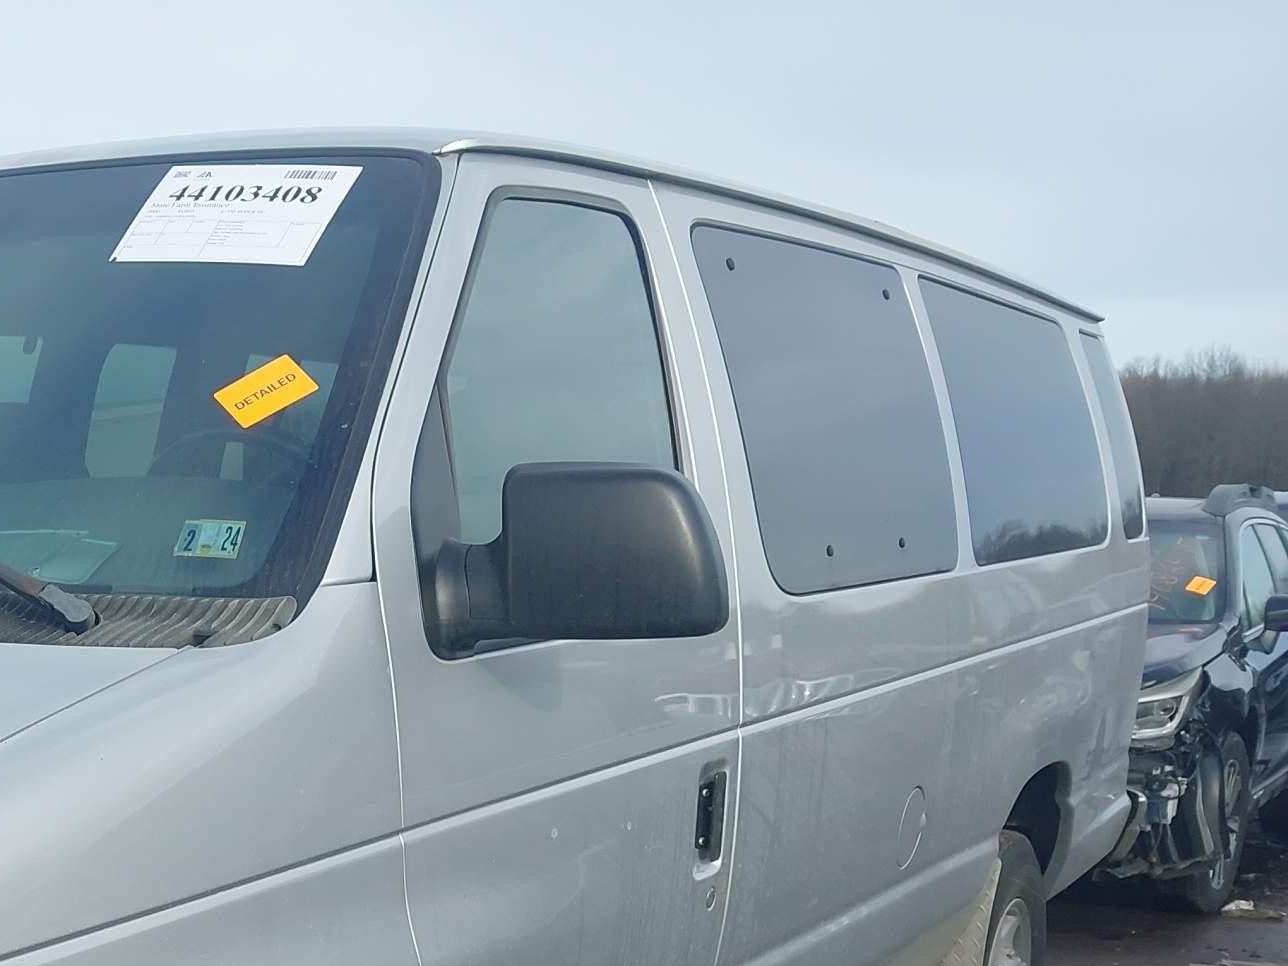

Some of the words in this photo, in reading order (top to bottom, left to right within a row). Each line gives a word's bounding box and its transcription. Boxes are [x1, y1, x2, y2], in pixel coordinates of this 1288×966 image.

[169, 184, 323, 204] 44103408
[233, 373, 297, 411] DETAILED
[183, 529, 197, 552] 2
[220, 526, 242, 553] 24
